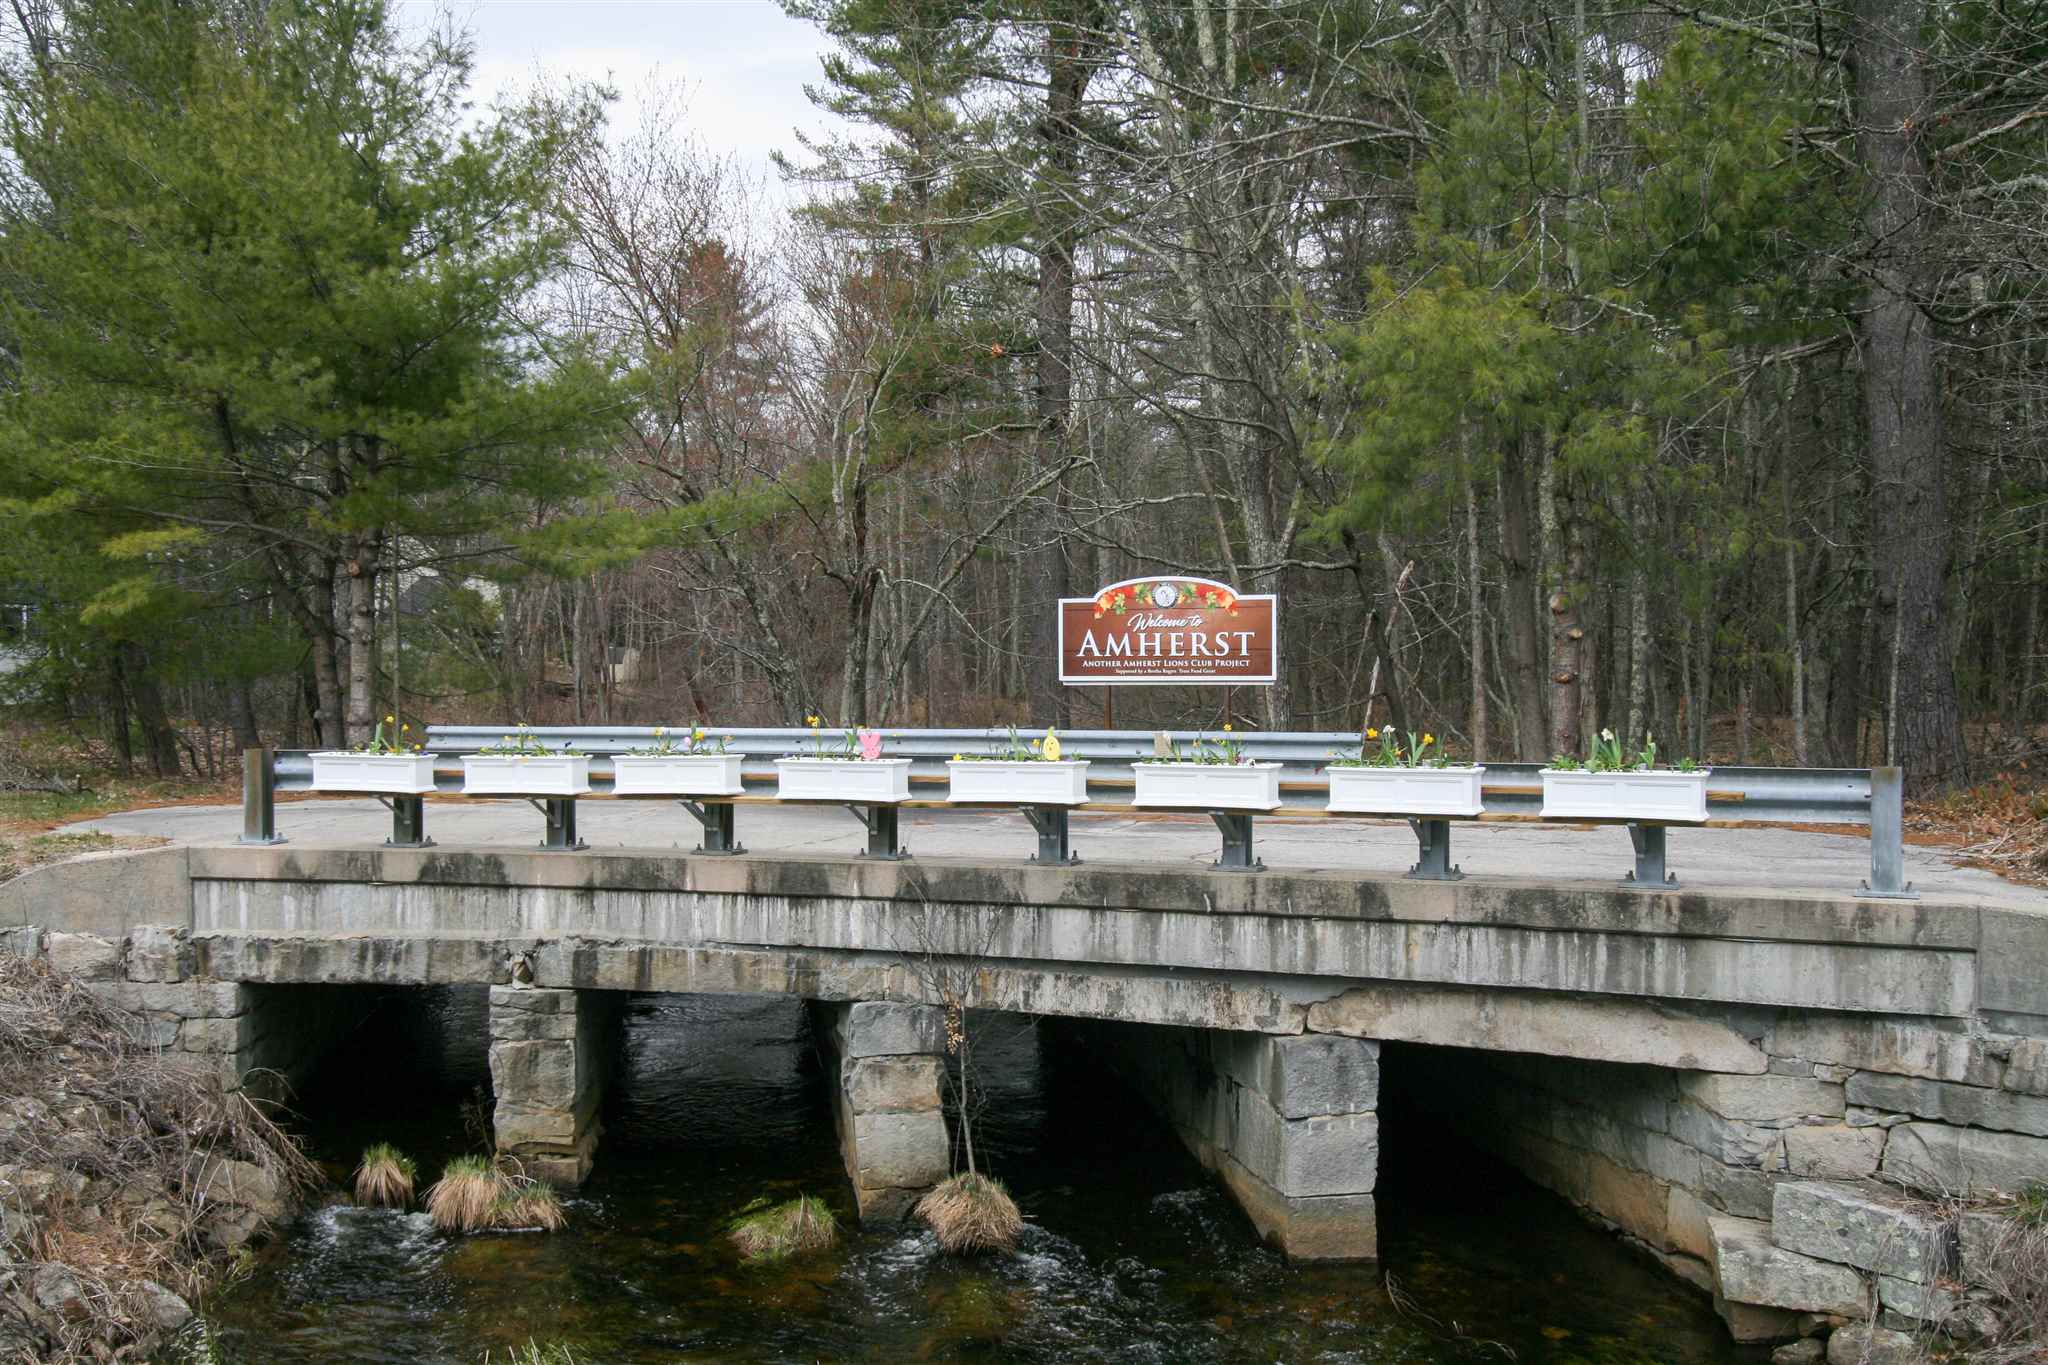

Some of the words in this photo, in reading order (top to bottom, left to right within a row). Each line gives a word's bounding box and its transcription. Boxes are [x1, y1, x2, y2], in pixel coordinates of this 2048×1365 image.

[1127, 613, 1187, 632] Welcome
[1187, 615, 1204, 628] to
[1076, 629, 1256, 657] AMHERST
[1082, 660, 1121, 668] ANOTHER
[1163, 659, 1188, 667] LIONS
[1190, 659, 1213, 667] CLUB
[1215, 659, 1250, 667] PROJECT
